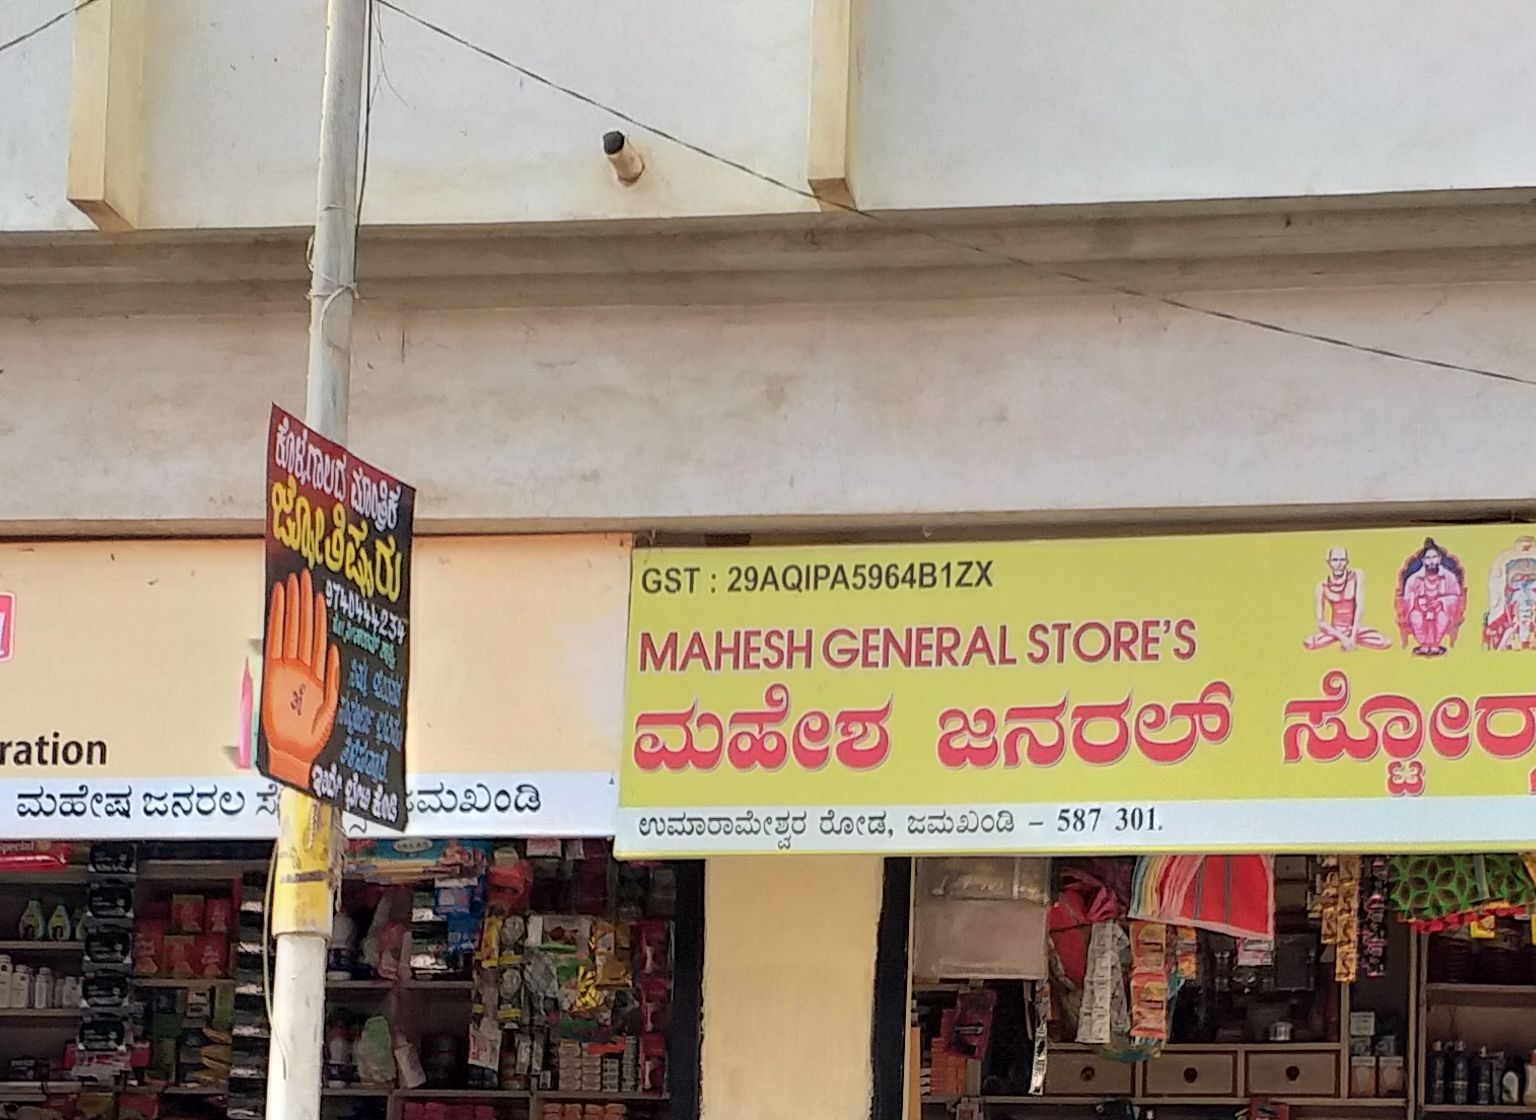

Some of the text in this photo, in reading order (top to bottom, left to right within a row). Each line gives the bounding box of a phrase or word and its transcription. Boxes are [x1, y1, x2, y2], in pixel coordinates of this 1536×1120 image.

[641, 567, 702, 595] GST
[726, 560, 994, 593] 29AQIPA5964B1ZX
[638, 628, 813, 673] MAHESH
[821, 622, 1017, 670] GENERAL
[632, 683, 894, 774] ಮಹೇಶ
[936, 681, 1233, 771] ಜನರಲ್
[15, 785, 134, 819] ಮಹೇಷ
[141, 787, 246, 817] ಜನರಲ
[407, 783, 542, 816] ಮಖಂಡಿ
[906, 809, 1015, 837] ಜಮಖಂಡಿ
[1056, 808, 1101, 834] 587
[1115, 807, 1165, 833] 301.
